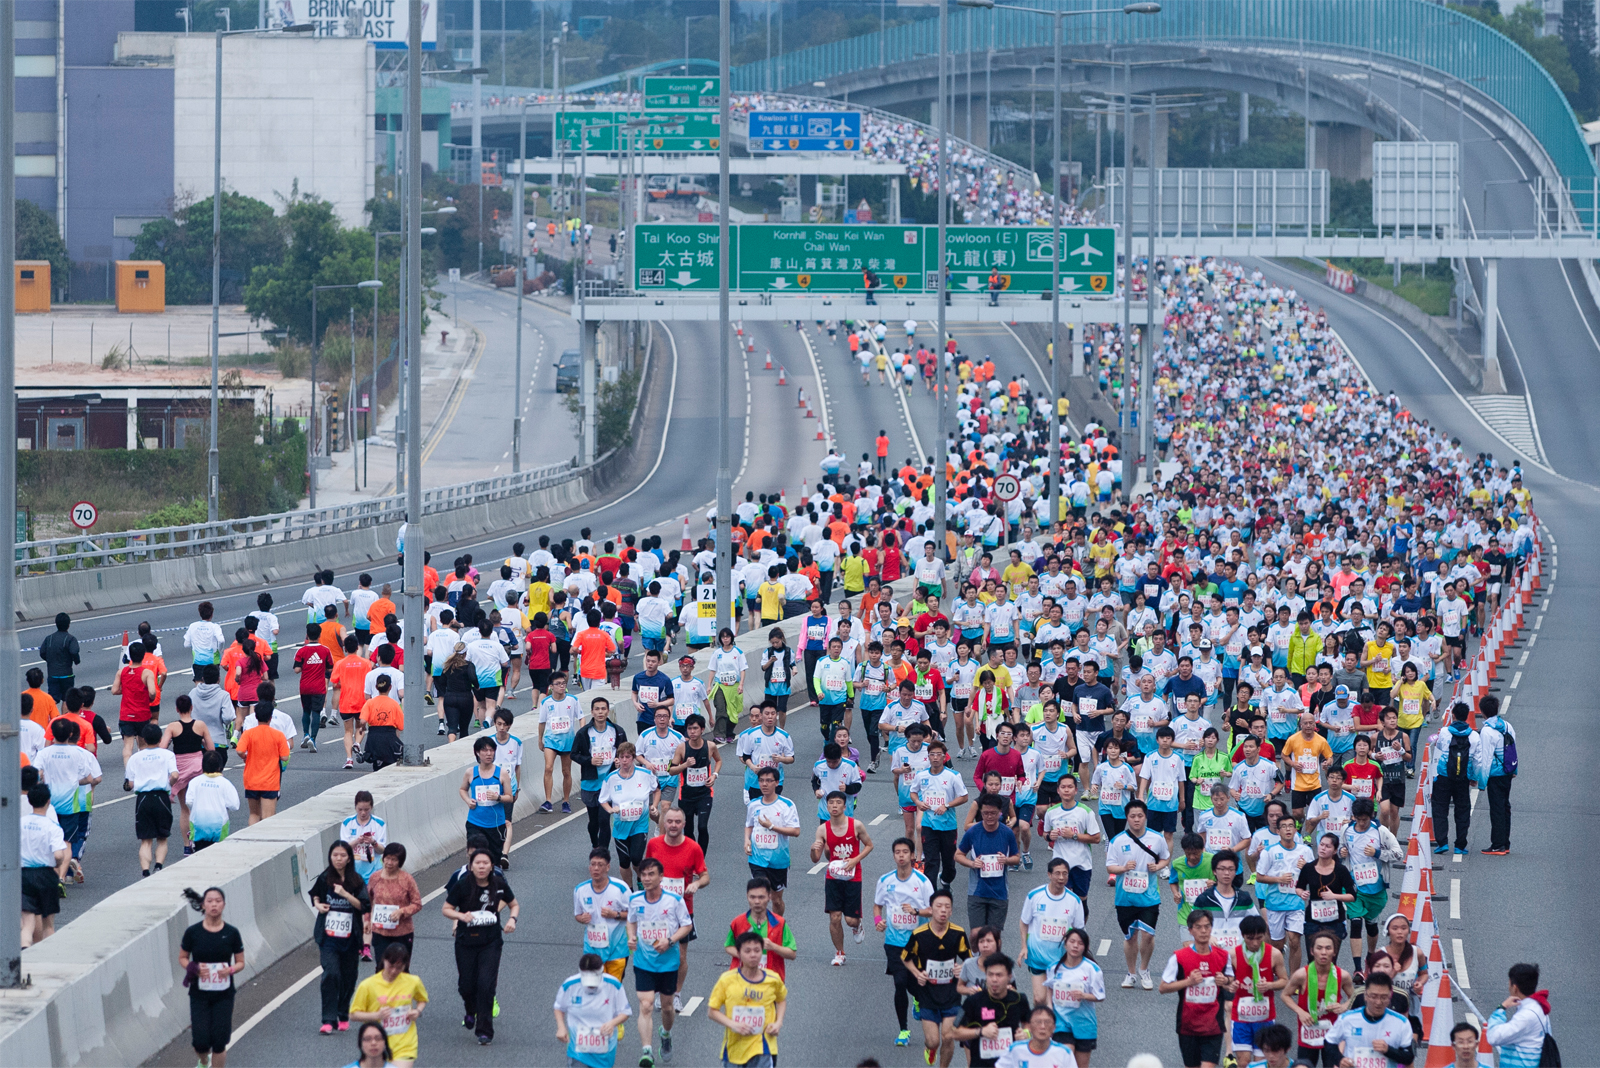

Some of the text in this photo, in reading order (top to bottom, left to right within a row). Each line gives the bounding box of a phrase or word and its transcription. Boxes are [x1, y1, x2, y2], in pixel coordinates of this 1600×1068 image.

[363, 0, 394, 17] OUT
[642, 232, 726, 244] Tai Koo Shin
[815, 231, 839, 240] Shau
[844, 231, 859, 240] Kei
[863, 232, 885, 240] Wan
[804, 242, 850, 251] Chai Wan
[658, 250, 714, 267] 太古城
[654, 271, 663, 284] 4
[800, 276, 807, 285] 4
[897, 277, 904, 286] 4
[1094, 278, 1103, 288] 2
[997, 482, 1015, 493] 70
[75, 510, 93, 520] 70
[703, 589, 710, 600] 2
[325, 918, 350, 931] A2759
[642, 929, 668, 940] B2567
[1188, 985, 1217, 997] B6427
[1240, 1004, 1268, 1016] B2052
[1356, 1056, 1386, 1068] B2836
